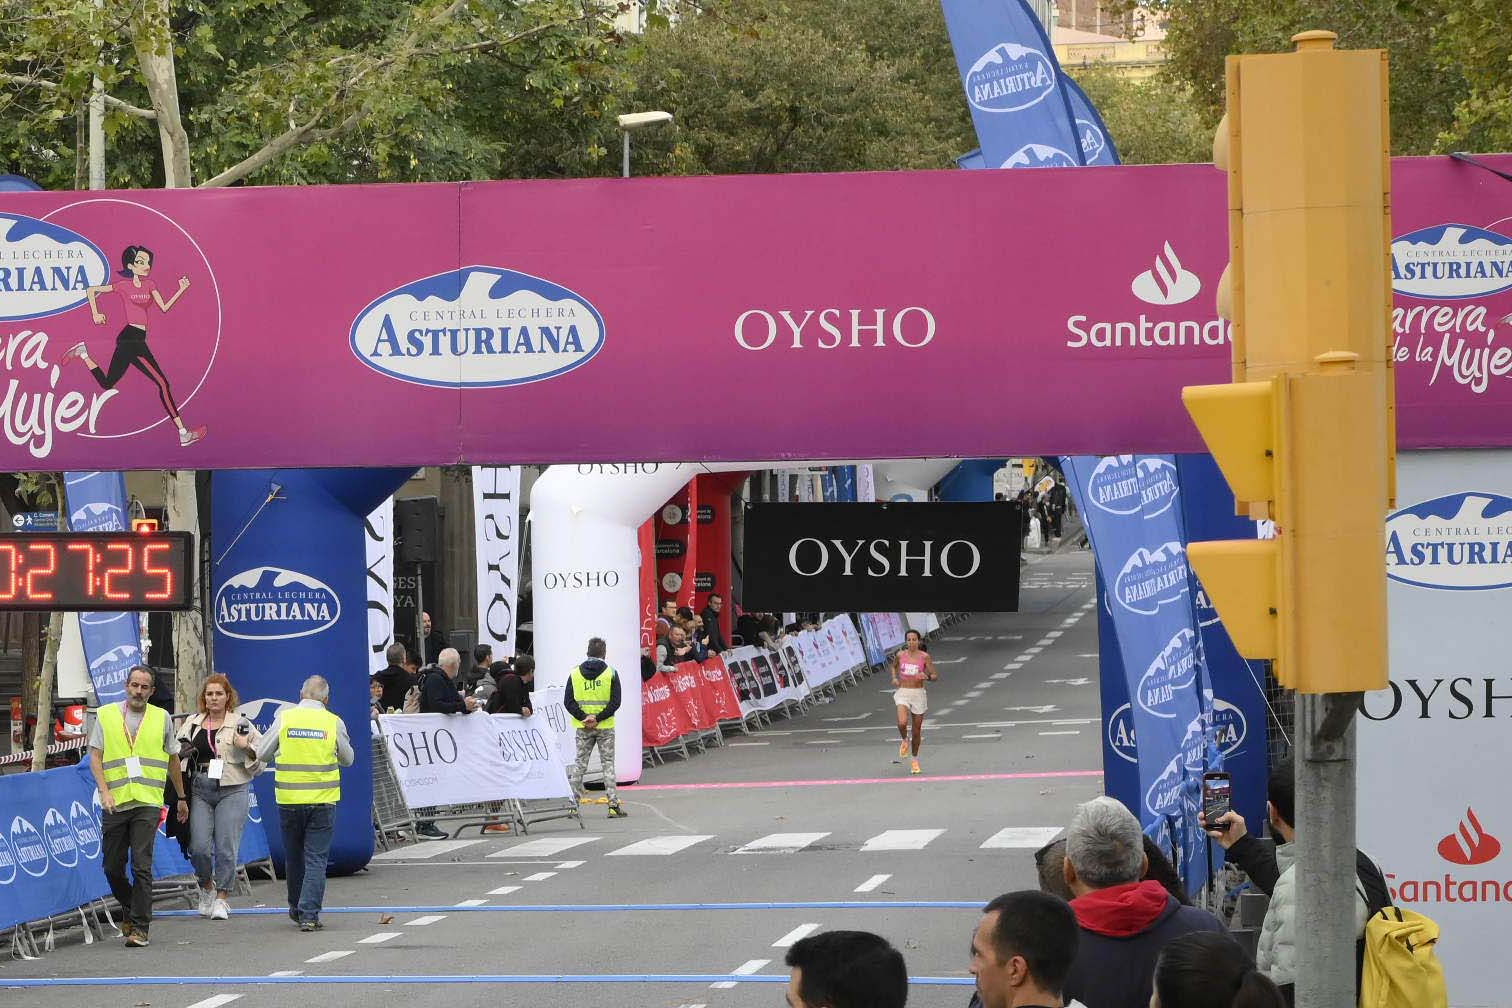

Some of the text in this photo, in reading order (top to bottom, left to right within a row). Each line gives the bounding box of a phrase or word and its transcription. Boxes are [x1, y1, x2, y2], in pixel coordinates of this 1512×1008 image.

[12, 249, 86, 261] LECHERA
[1405, 250, 1458, 258] CENTRAL
[408, 307, 577, 321] CENTRAL LECHERA
[733, 306, 936, 351] OYSHO
[1392, 304, 1488, 334] arrera
[369, 313, 585, 357] ASTURIANA
[1066, 314, 1232, 349] Santand
[1415, 335, 1434, 362] la
[1428, 328, 1512, 394] Muje
[1412, 526, 1481, 537] CENTRAL
[787, 536, 982, 579] OYSHO
[1384, 528, 1512, 567] ASTURIA
[543, 570, 620, 590] OYSHO
[217, 598, 332, 625] ASTURIANA
[231, 592, 327, 601] CENTRAL LECHERA
[583, 679, 602, 691] Life
[1358, 677, 1512, 721] OYSH
[393, 728, 458, 769] SHO
